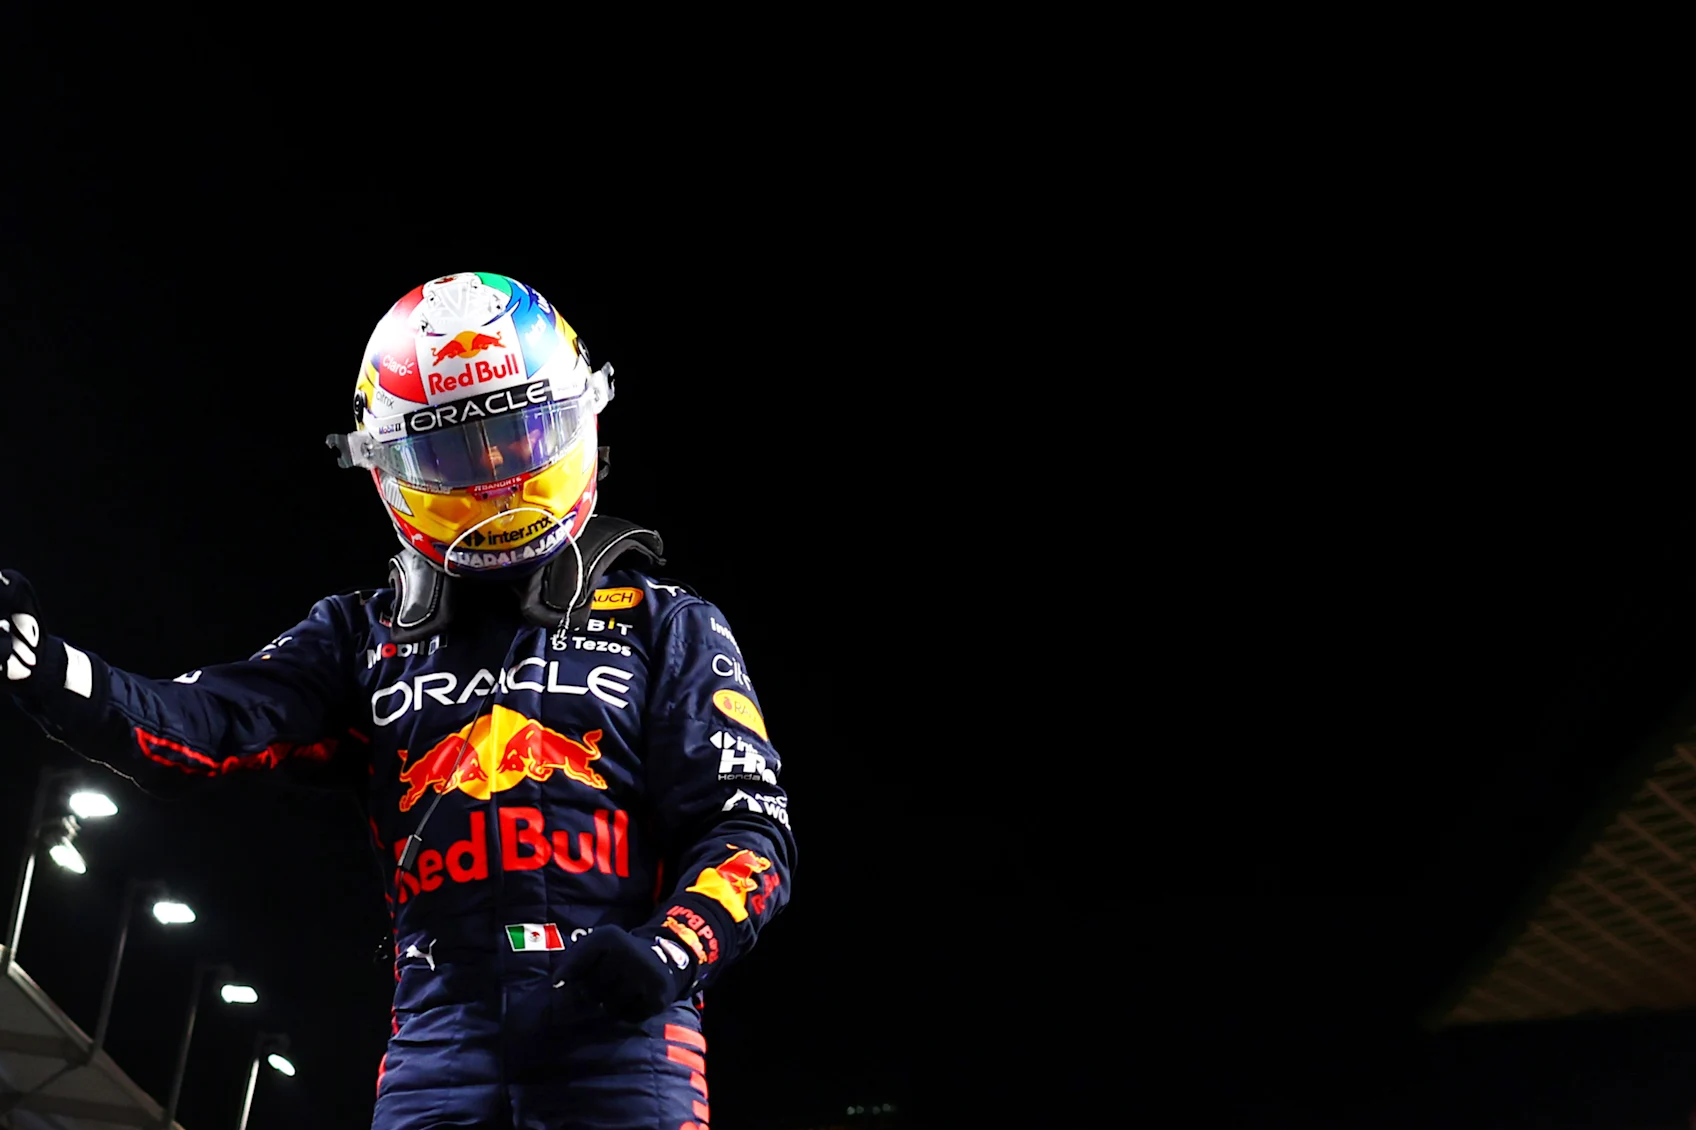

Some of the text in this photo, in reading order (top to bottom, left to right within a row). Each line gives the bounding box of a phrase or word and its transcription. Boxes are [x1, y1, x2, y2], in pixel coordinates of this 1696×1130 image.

[382, 354, 407, 376] Claro
[428, 353, 520, 396] Red Bull
[410, 381, 548, 432] ORACLE
[488, 514, 553, 546] inter.mx
[572, 636, 632, 657] Tezos
[371, 657, 634, 727] ORACLE
[498, 806, 630, 878] Bull
